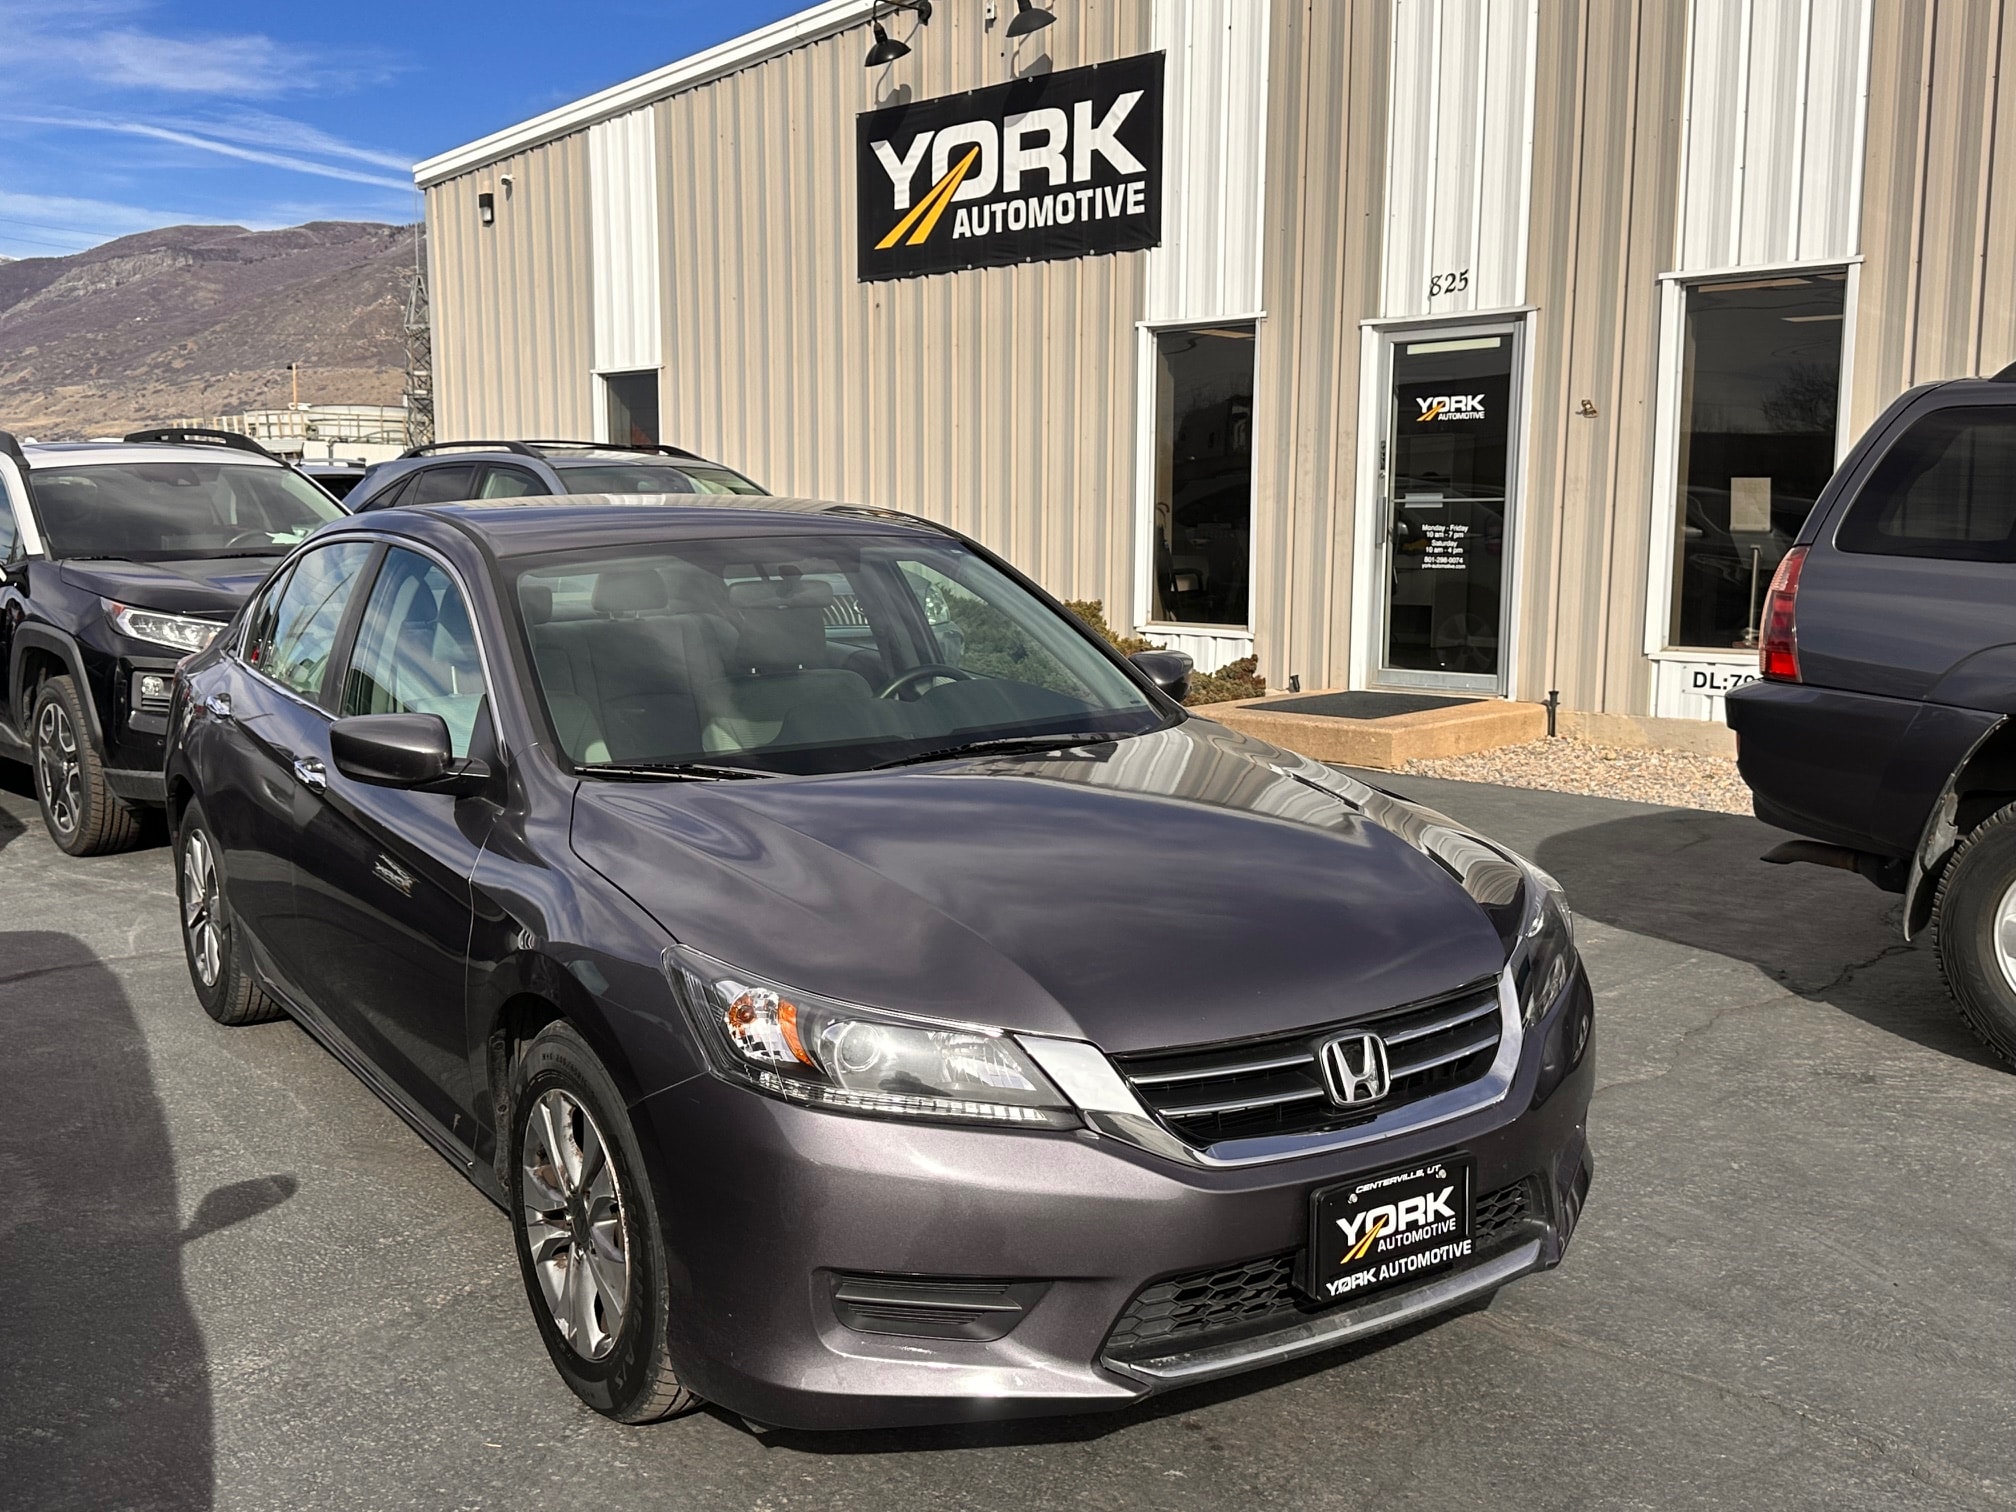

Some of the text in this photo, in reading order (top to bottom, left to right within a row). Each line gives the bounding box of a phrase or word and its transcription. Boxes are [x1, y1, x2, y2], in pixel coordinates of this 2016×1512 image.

[870, 90, 1147, 210] YORK
[952, 181, 1145, 239] AUTOMOTIVE
[1429, 269, 1469, 296] 825
[1416, 394, 1485, 414] YORK
[1438, 409, 1485, 421] AUTOMOTIVE
[1422, 524, 1446, 533] Monday
[1450, 524, 1469, 533] Friday
[1431, 539, 1458, 548] Saturday
[1355, 1164, 1441, 1193] CENTERVILLE, UT
[1336, 1186, 1455, 1246] YORK
[1377, 1217, 1456, 1253] AUTOMOTIVE
[1326, 1239, 1472, 1296] YORK AUTOMOTIVE
